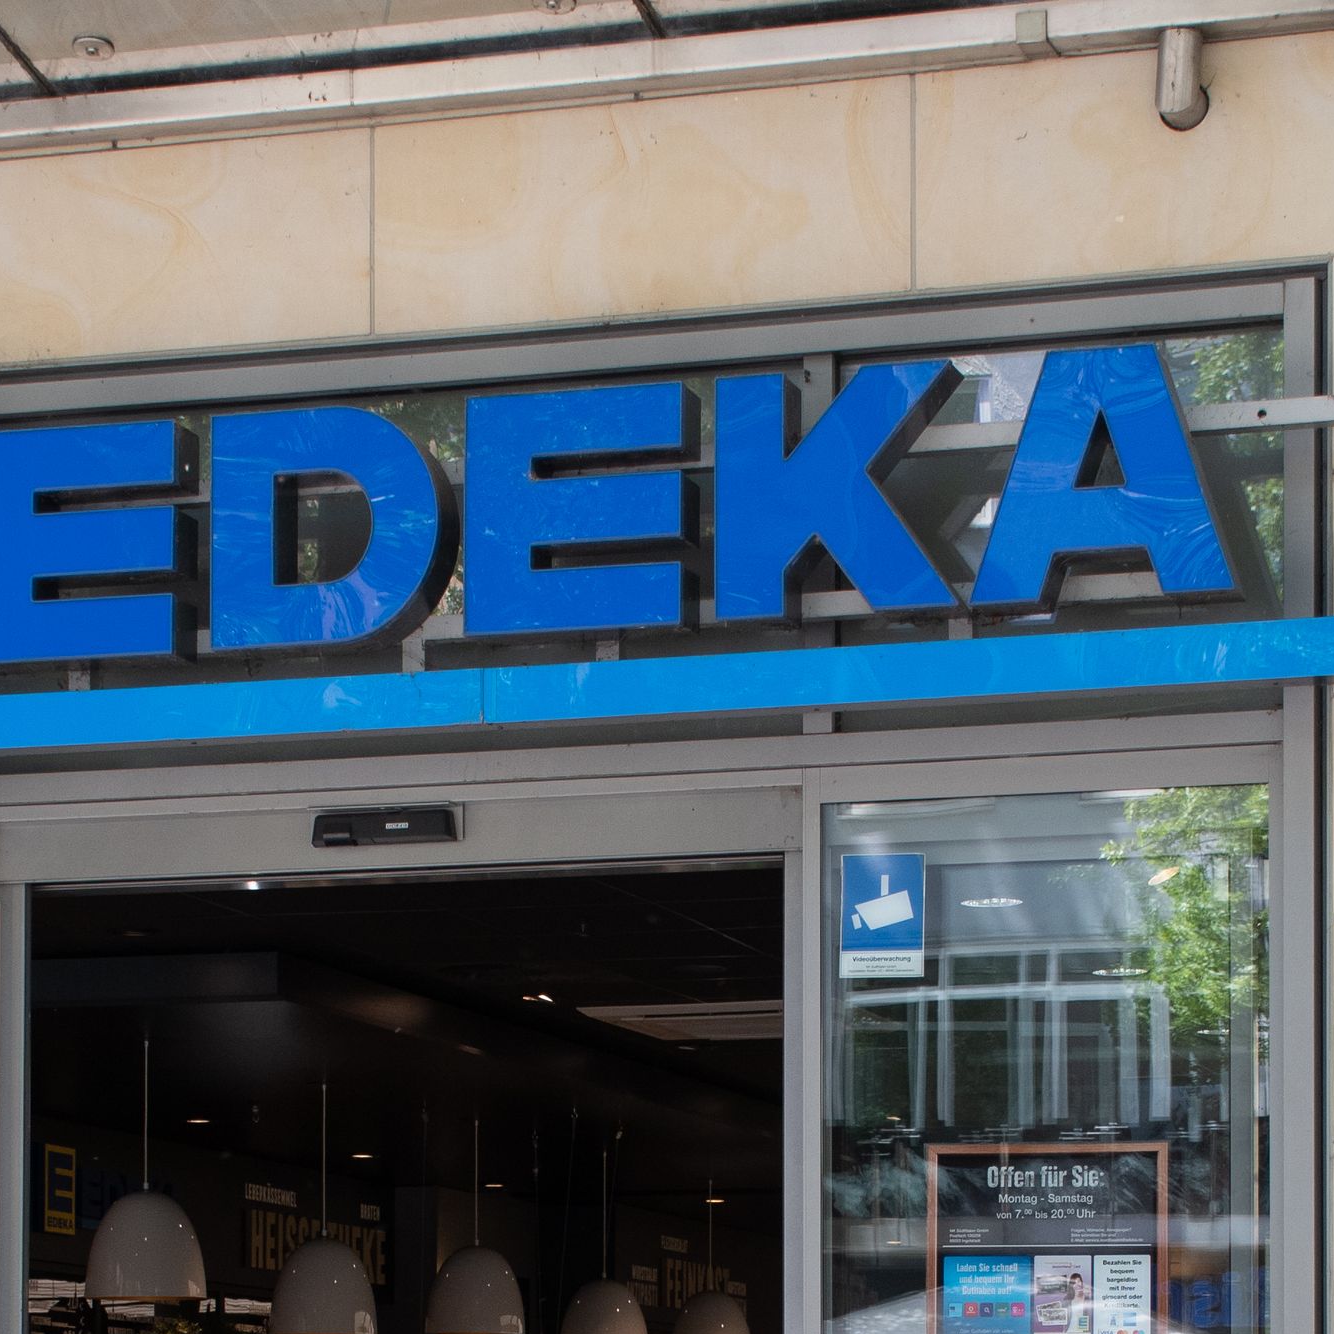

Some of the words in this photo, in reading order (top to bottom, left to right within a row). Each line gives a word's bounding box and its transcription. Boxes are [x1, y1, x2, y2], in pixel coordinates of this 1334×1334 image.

[987, 1166, 1034, 1188] Offen
[1041, 1166, 1067, 1187] für
[1072, 1165, 1105, 1187] Sie:
[999, 1194, 1037, 1205] Montag
[1048, 1194, 1093, 1204] Samstag
[1035, 1210, 1048, 1219] bis
[1076, 1209, 1096, 1218] Uhr
[47, 1217, 74, 1230] EDEKA
[957, 1263, 976, 1272] Laden
[979, 1263, 990, 1272] Sie
[992, 1263, 1018, 1272] schnell
